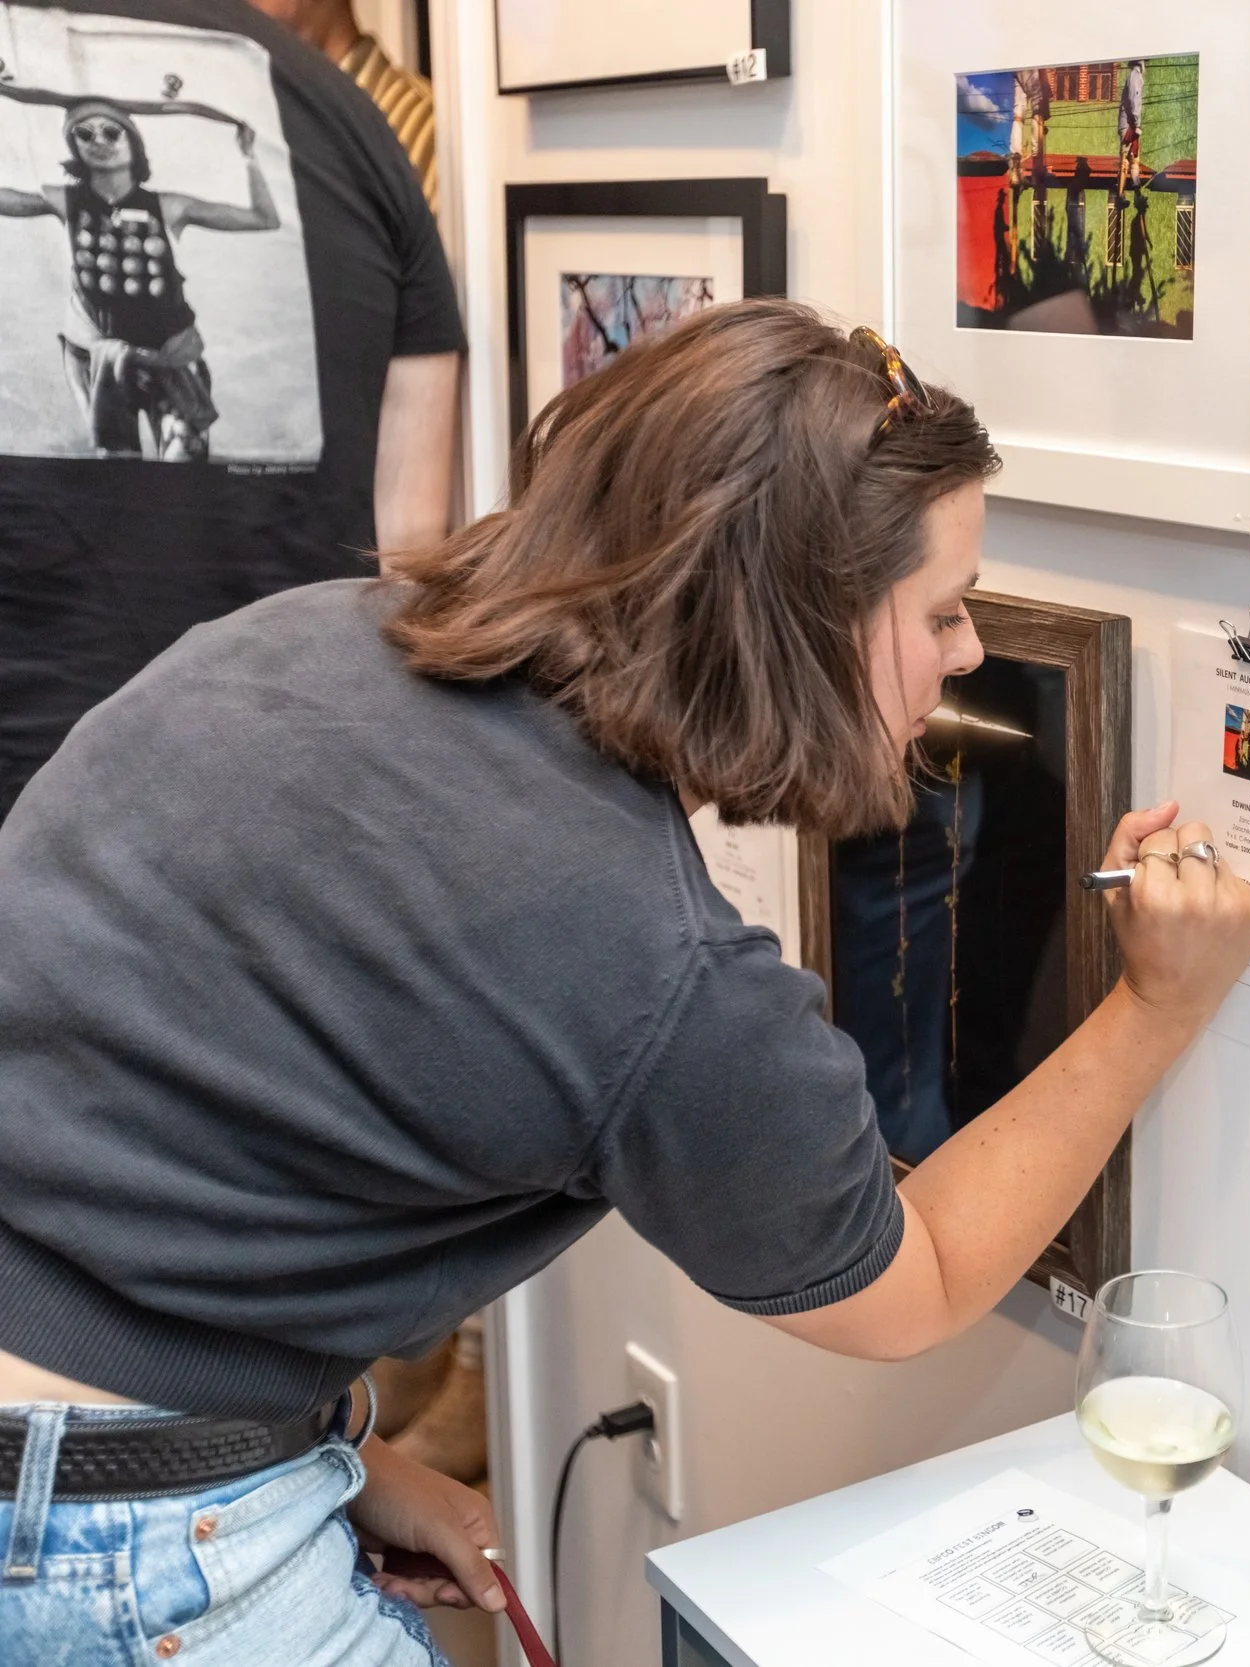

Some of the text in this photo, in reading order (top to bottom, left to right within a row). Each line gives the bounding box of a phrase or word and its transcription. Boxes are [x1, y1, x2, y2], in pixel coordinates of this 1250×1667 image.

[733, 53, 757, 80] #12
[1215, 668, 1237, 680] SILENT
[1231, 800, 1250, 812] EDWIN
[1055, 1285, 1087, 1318] #17
[953, 1537, 974, 1552] FEST
